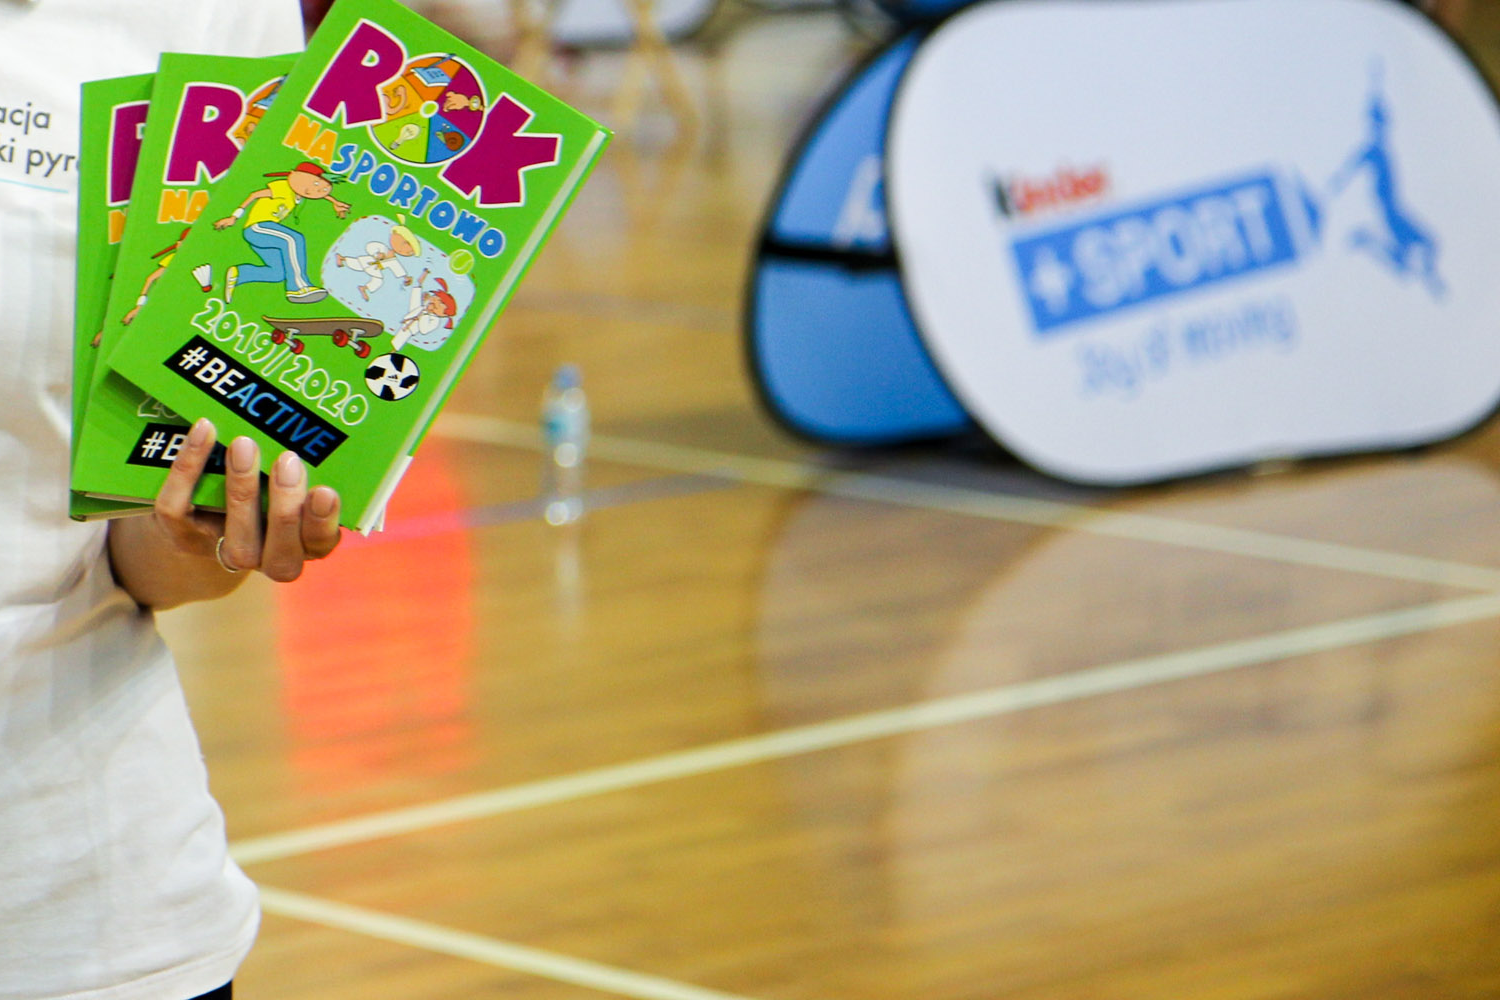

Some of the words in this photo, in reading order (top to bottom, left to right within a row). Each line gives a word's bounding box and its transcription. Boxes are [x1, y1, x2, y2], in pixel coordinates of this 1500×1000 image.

[25, 148, 81, 178] pyr
[302, 17, 563, 208] ROK
[178, 345, 337, 458] #BEACTIVE
